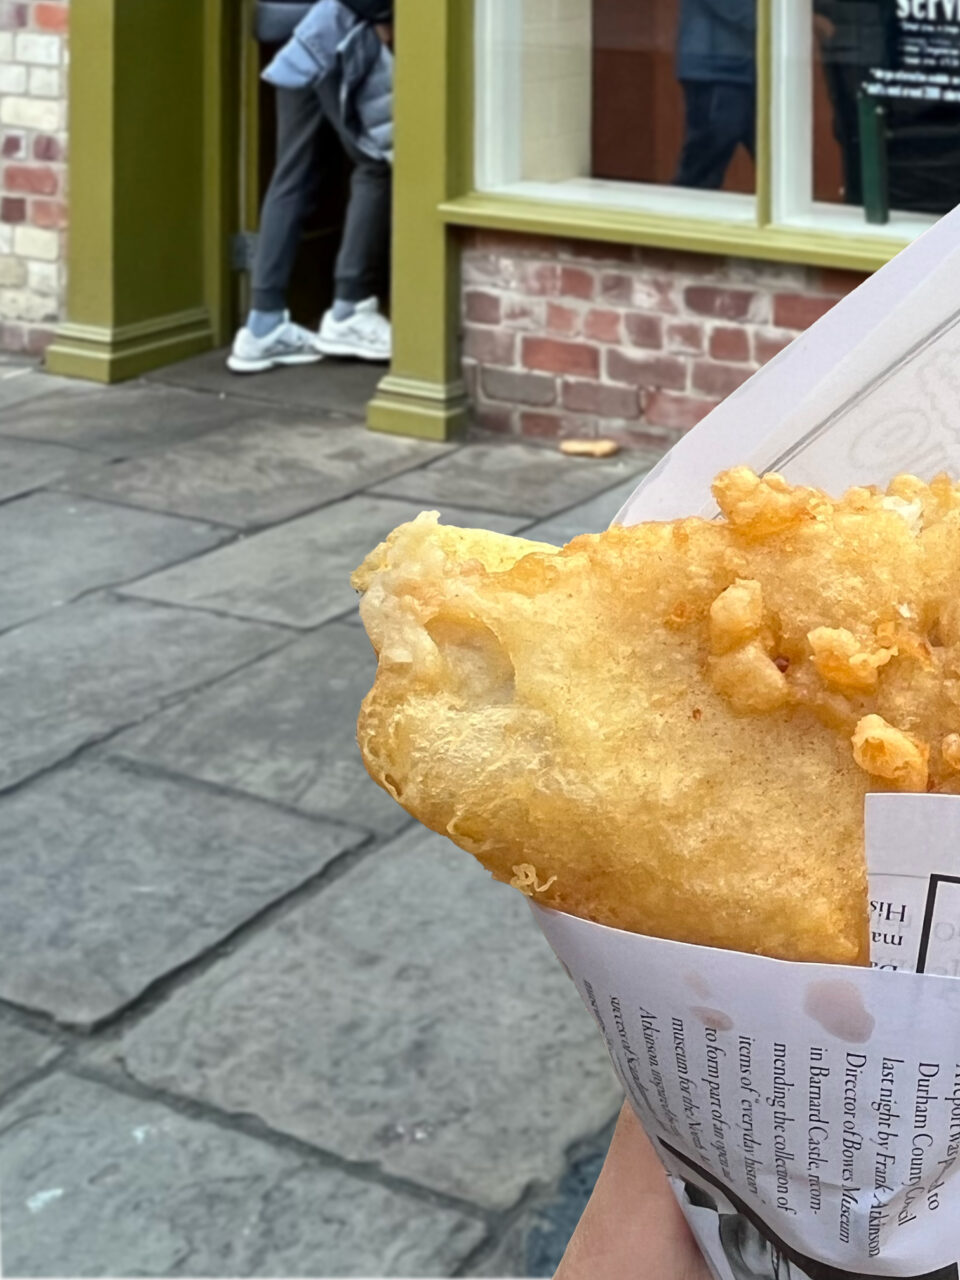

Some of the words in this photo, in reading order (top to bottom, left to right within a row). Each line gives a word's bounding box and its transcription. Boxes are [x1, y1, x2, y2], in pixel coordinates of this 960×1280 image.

[671, 1017, 689, 1074] museum
[704, 1027, 718, 1042] to
[705, 1043, 727, 1079] form
[738, 1035, 756, 1076] items
[810, 1047, 828, 1061] in
[677, 1074, 698, 1097] for
[740, 1077, 761, 1099] of
[765, 1042, 795, 1107] mending
[843, 1052, 867, 1119] Director
[882, 1057, 905, 1086] last
[684, 1096, 700, 1118] the
[701, 1077, 723, 1108] part
[808, 1065, 830, 1124] Barnard
[871, 1087, 900, 1129] night
[914, 1062, 940, 1129] Durham
[711, 1108, 732, 1129] of
[713, 1125, 726, 1142] an
[774, 1109, 796, 1133] the
[842, 1120, 864, 1141] of
[807, 1126, 829, 1171] Castle,
[869, 1130, 899, 1151] by
[774, 1134, 795, 1195] collection
[841, 1138, 862, 1183] Bowes
[874, 1151, 897, 1192] Frank
[901, 1132, 934, 1187] County
[776, 1196, 797, 1216] of
[838, 1184, 861, 1244] Museum
[926, 1192, 941, 1211] to
